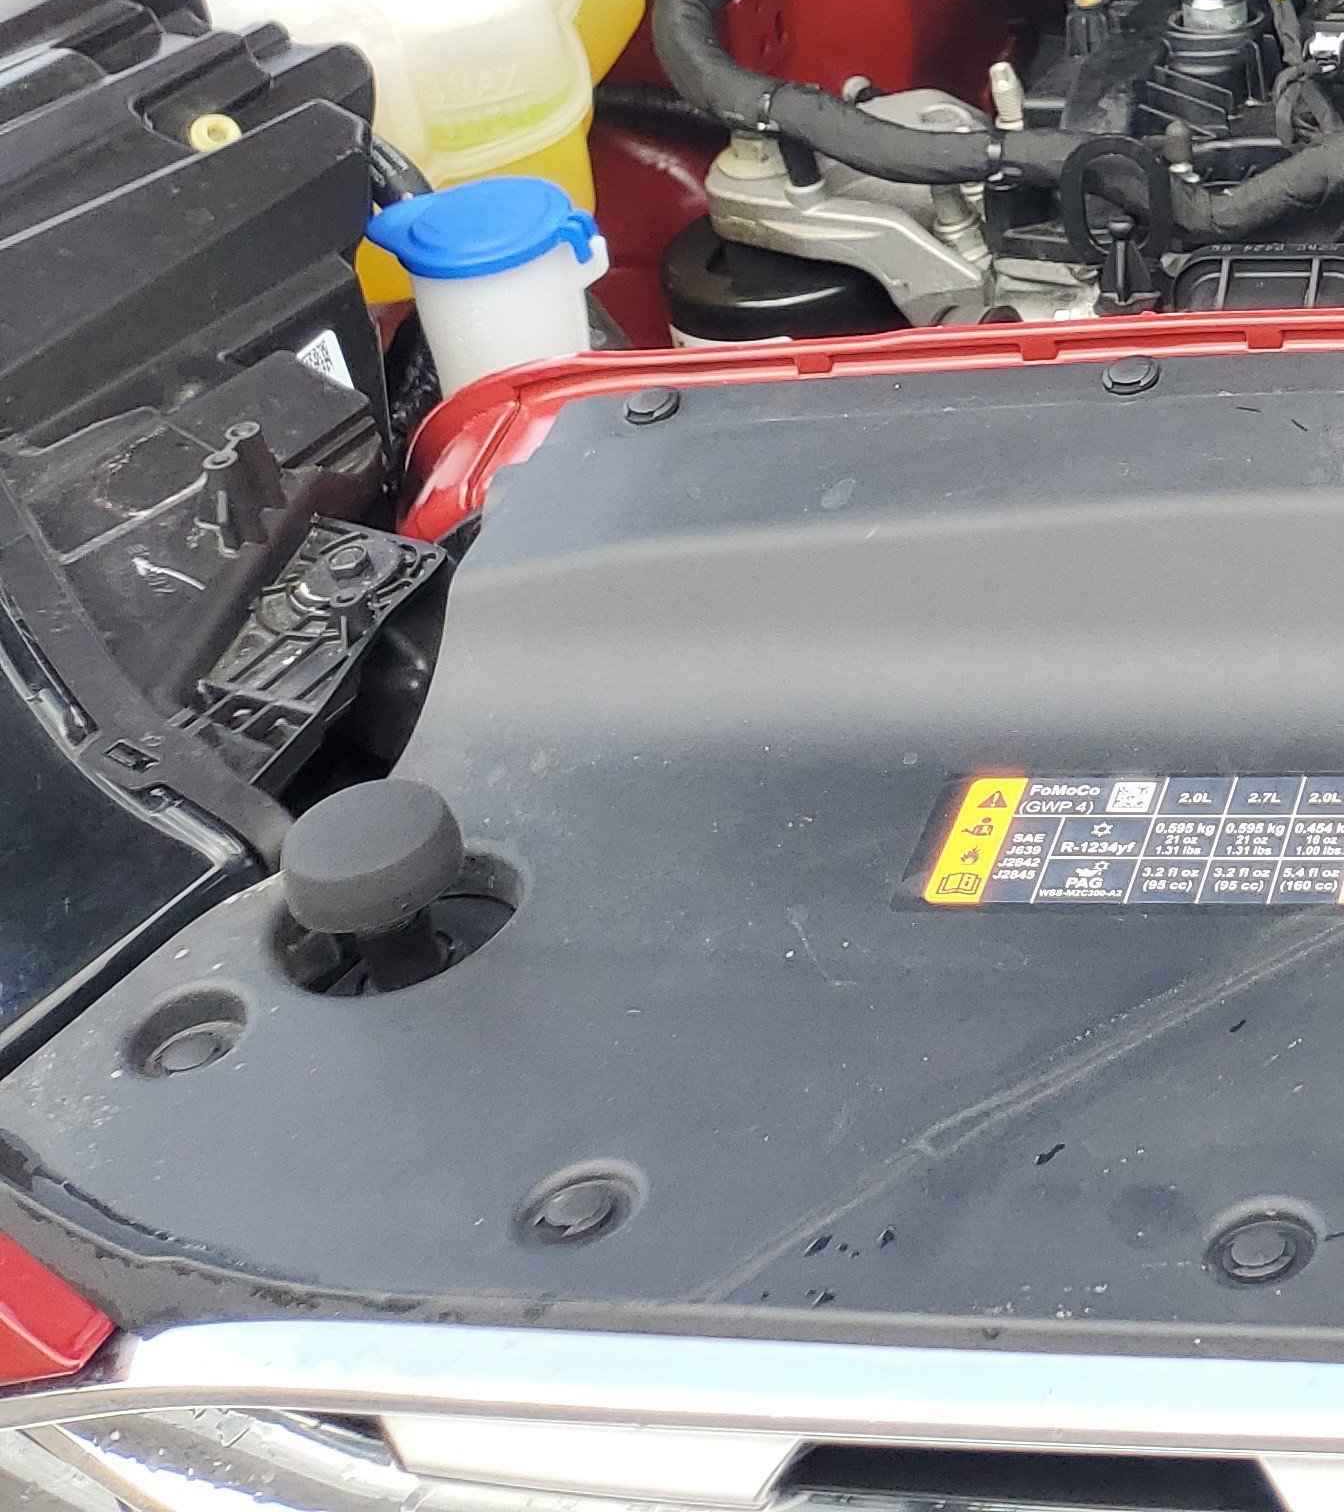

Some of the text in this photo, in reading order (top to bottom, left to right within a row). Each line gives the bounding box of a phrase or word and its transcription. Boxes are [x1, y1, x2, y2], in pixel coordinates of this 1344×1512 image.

[1029, 784, 1101, 797] FoMoCo
[1178, 792, 1212, 804] 2.0L
[1247, 792, 1281, 804] 2.7L
[1308, 792, 1342, 804] 2.0L
[1018, 800, 1094, 815] (GWP 4)
[1155, 822, 1216, 837] 0.595 kg
[1225, 822, 1286, 837] 0.595 kg
[1294, 822, 1335, 834] 0.454
[1012, 833, 1046, 843] SAE
[1164, 835, 1198, 845] 21 oz
[1235, 835, 1268, 845] 21 oz
[1305, 835, 1338, 845] 16 oz
[1005, 845, 1042, 855] J639
[1059, 841, 1136, 855] R-1234yf
[1155, 846, 1201, 855] 1.31 lbs
[1225, 846, 1272, 855] 1.31 lbs
[1295, 846, 1320, 855] 1.00
[997, 857, 1040, 867] J2842
[992, 869, 1037, 879] J2845
[1142, 867, 1200, 878] 3.2 fl oz
[1213, 867, 1271, 878] 3.2 fl oz
[1282, 867, 1340, 878] 5.4 fl oz
[1065, 877, 1104, 888] PAG
[1142, 880, 1193, 892] (95 cc)
[1214, 880, 1264, 892] (95 cc)
[1279, 880, 1338, 892] (160 cc)
